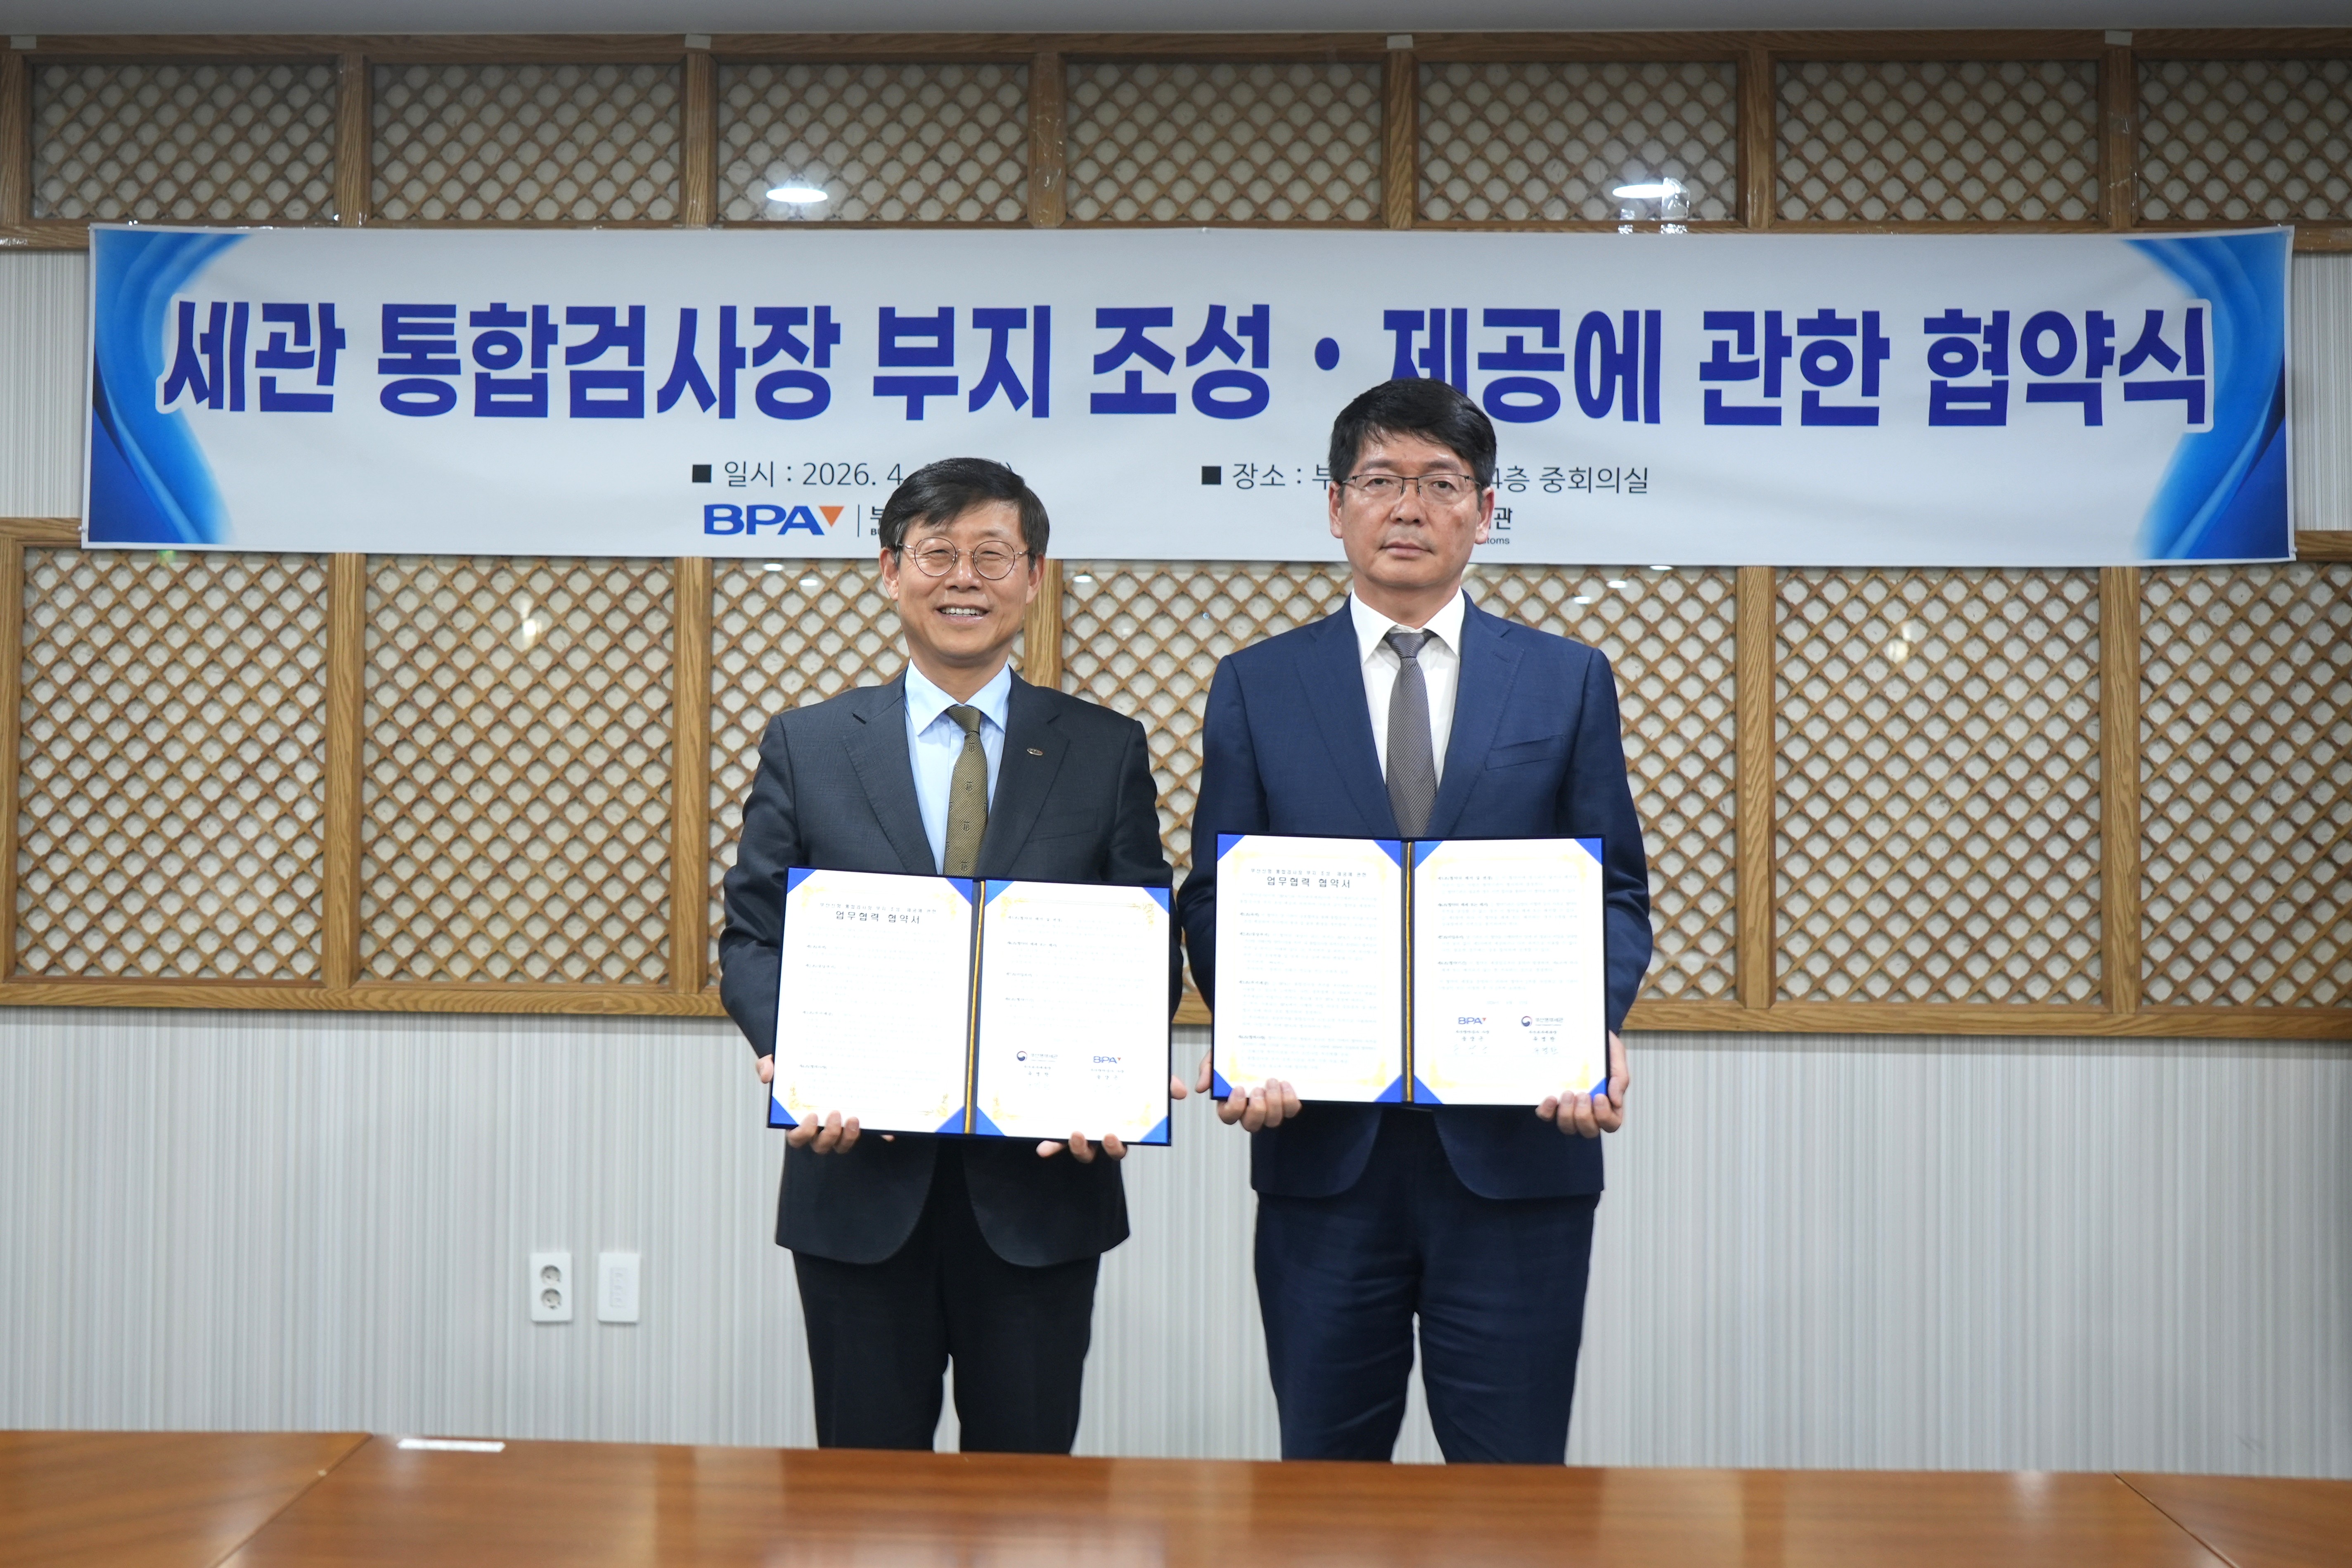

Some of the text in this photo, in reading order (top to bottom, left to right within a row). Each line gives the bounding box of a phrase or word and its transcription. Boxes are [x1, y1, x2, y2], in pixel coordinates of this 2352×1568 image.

[165, 302, 345, 412] 세관
[379, 303, 840, 419] 통합검사장
[874, 306, 1050, 420] 부지
[1091, 305, 1269, 419] 조성
[1384, 308, 1660, 424] 제공에
[1700, 309, 1890, 426] 관한
[1923, 308, 2208, 427] 협약식
[725, 461, 773, 487] 일시
[803, 462, 876, 486] 2026.
[1233, 463, 1286, 490] 장소
[1539, 467, 1648, 494] 중회의실
[704, 504, 825, 535] BPA
[1489, 507, 1513, 530] 관
[1267, 876, 1350, 888] 업무협력 협약서
[836, 911, 920, 924] 업무협력 협약서
[1093, 1056, 1118, 1064] BPA
